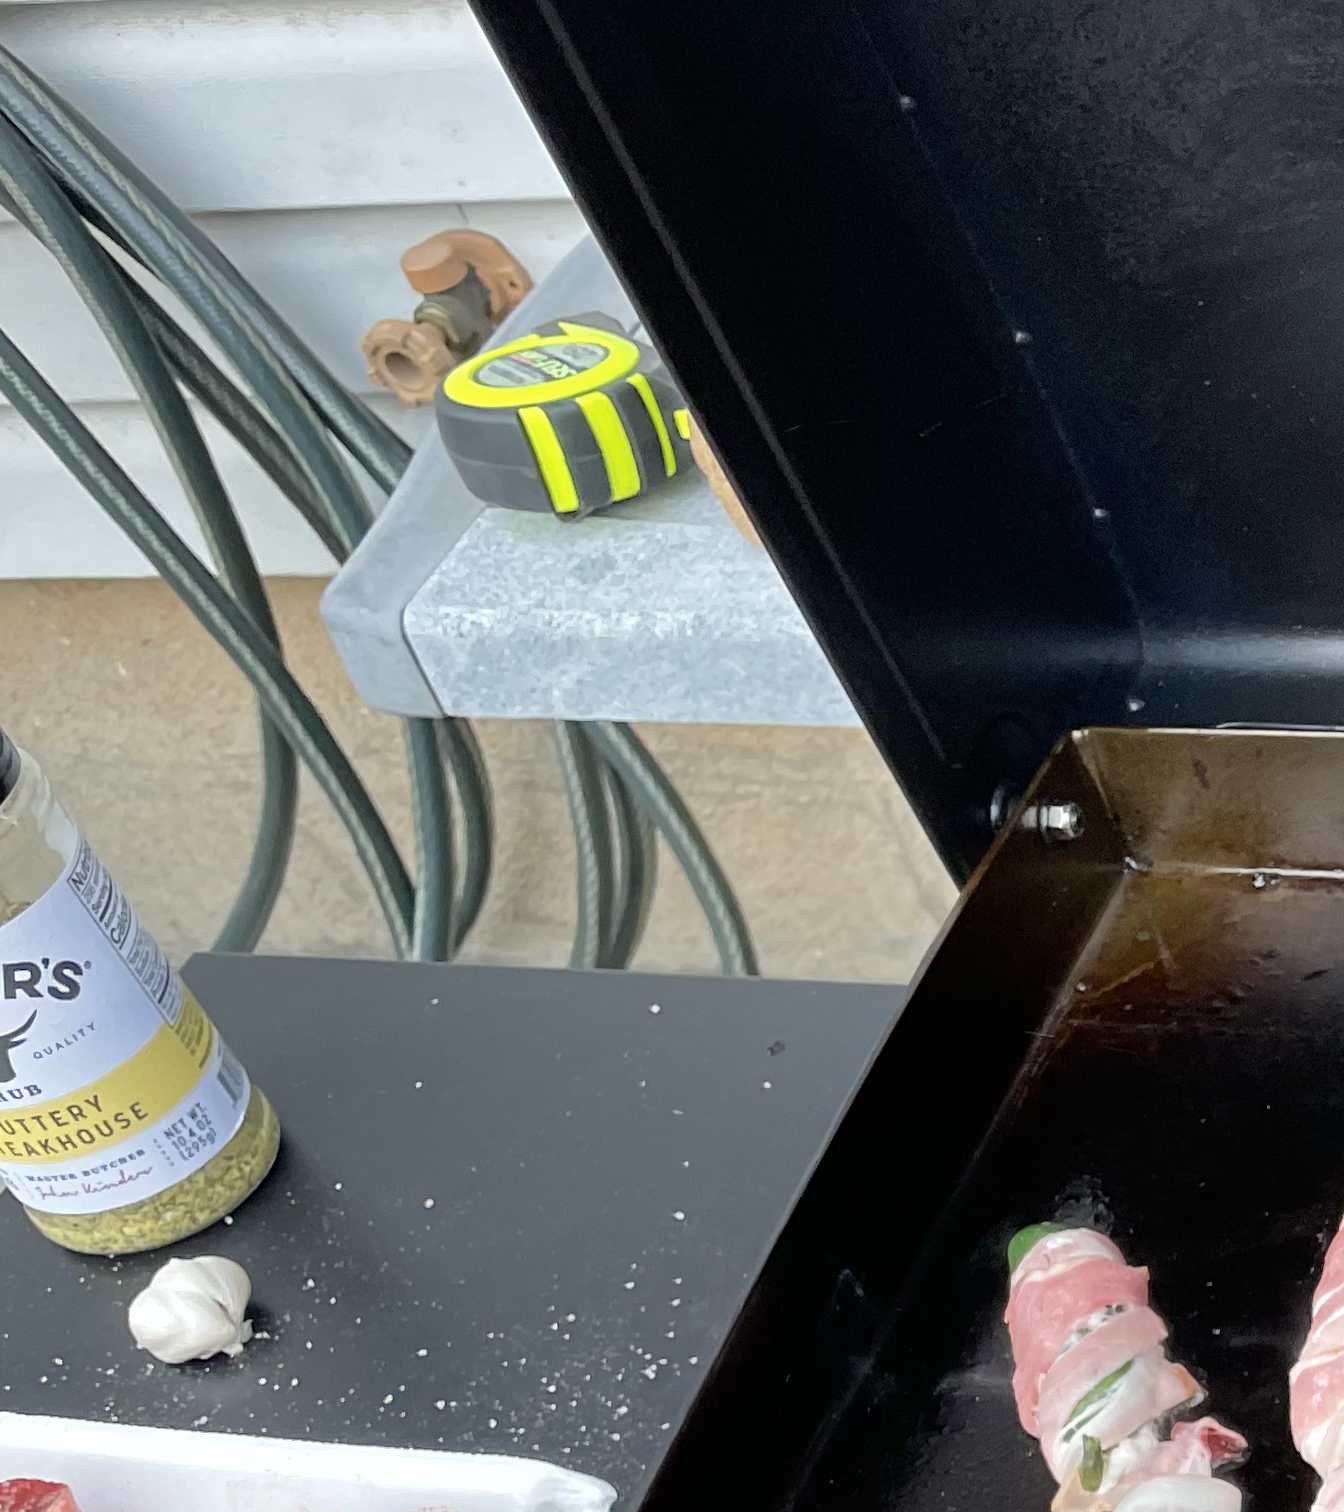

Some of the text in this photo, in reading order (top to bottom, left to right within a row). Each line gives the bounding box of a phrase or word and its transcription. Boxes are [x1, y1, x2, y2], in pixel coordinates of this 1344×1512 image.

[33, 1021, 96, 1059] QUALITY
[0, 1101, 150, 1157] EAKHOUSE
[163, 1117, 187, 1140] NET
[81, 1148, 146, 1177] BUTCHER
